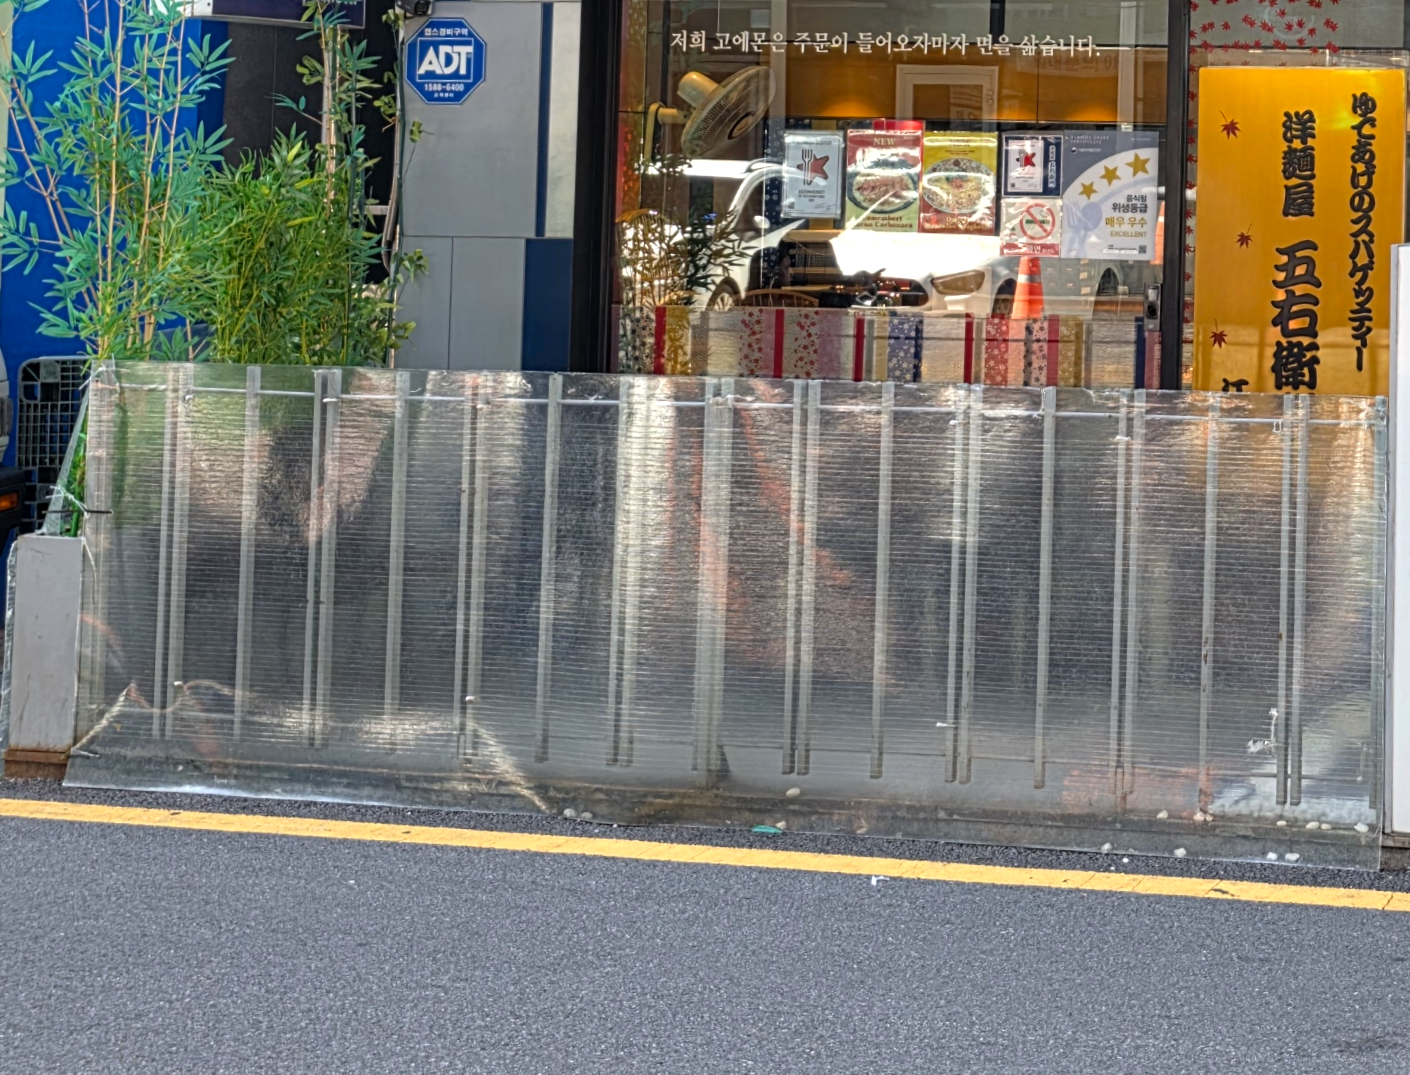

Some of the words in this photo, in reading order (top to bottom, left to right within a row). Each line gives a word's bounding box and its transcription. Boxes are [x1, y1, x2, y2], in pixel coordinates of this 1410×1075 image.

[670, 29, 706, 53] 저희
[712, 30, 788, 54] 고에몬은
[793, 31, 848, 54] 주문이
[855, 31, 970, 56] 들어오자마자
[1018, 34, 1101, 58] 삶습니다.
[416, 45, 474, 75] ADT
[424, 83, 465, 92] 1588-6400
[873, 137, 896, 145] NEW
[1126, 194, 1147, 203] 음식점
[1112, 202, 1148, 214] 위생등급
[1105, 216, 1125, 228] 매우
[1127, 216, 1148, 229] 우수
[1110, 230, 1147, 238] EXCELLENT
[1270, 239, 1323, 395] 五右衛
